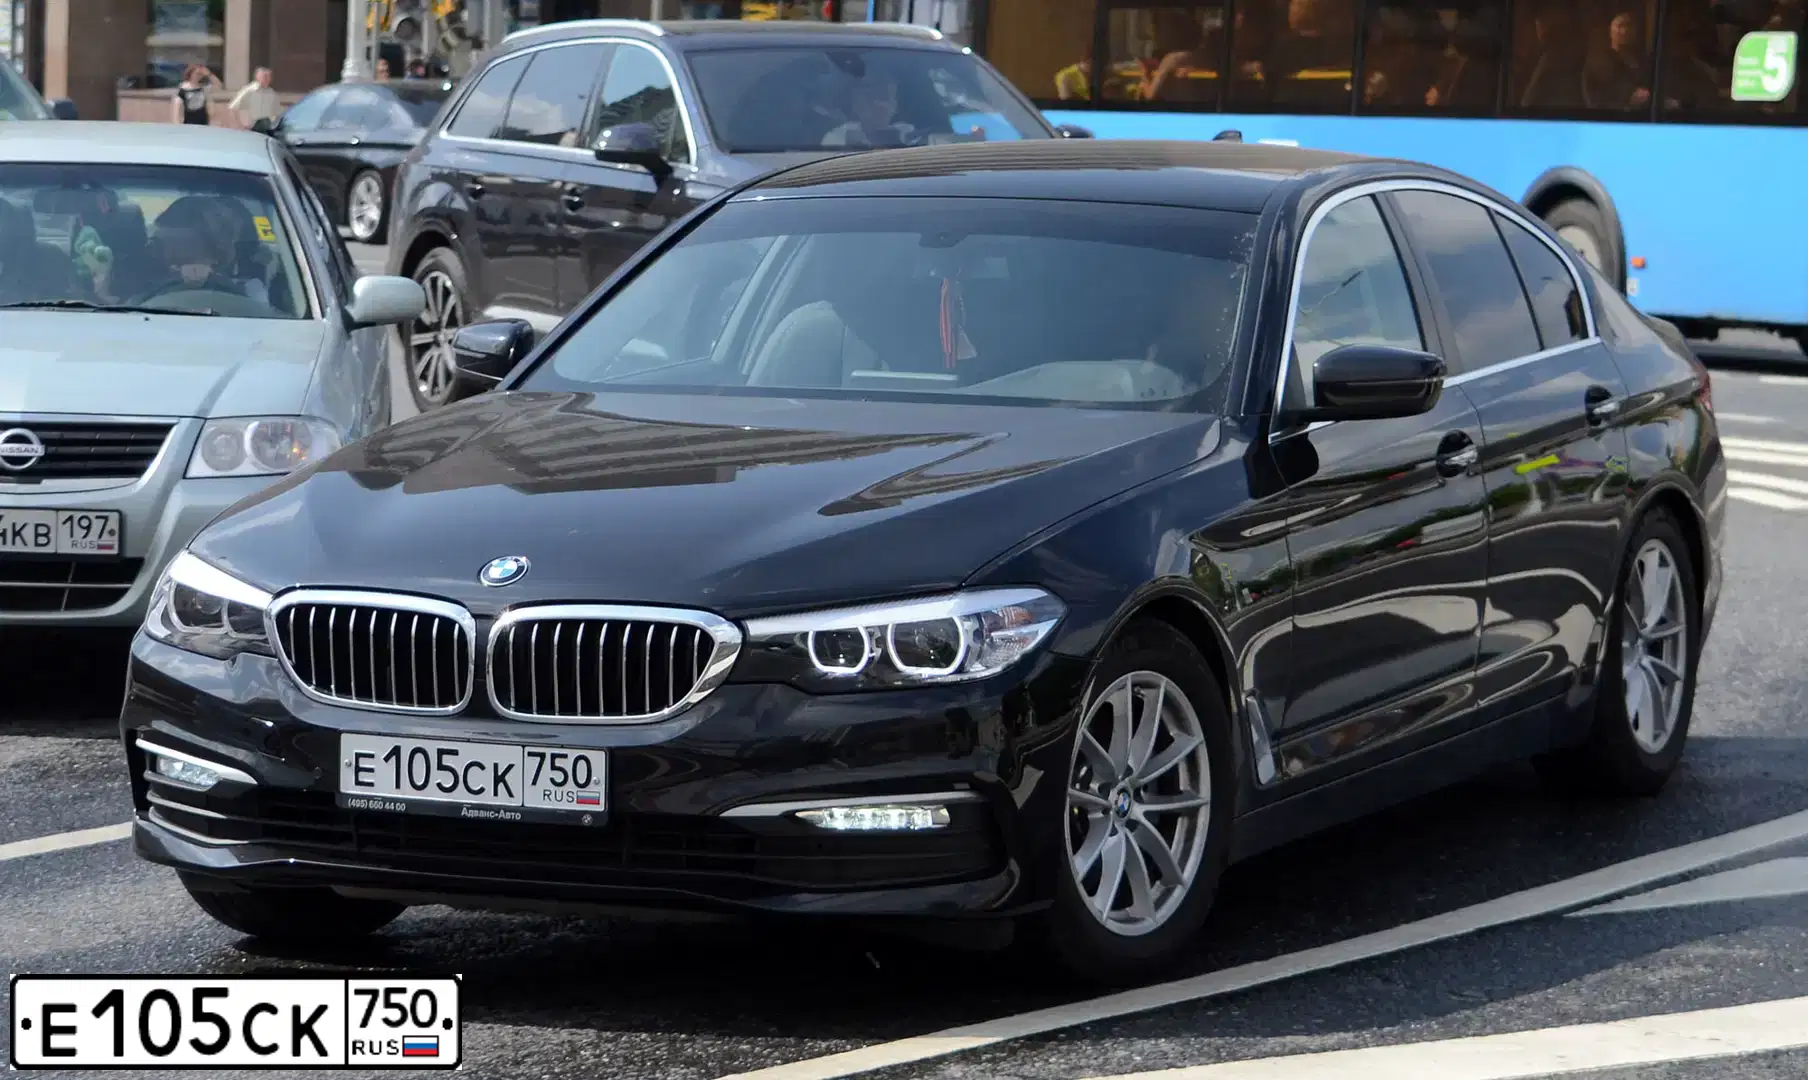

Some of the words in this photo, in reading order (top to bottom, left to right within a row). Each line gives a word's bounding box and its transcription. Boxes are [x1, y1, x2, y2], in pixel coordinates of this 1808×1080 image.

[1761, 36, 1787, 93] 5
[62, 514, 109, 540] 197
[71, 540, 96, 549] RUS
[527, 751, 592, 789] 750
[543, 789, 575, 803] RUS
[348, 798, 368, 809] (495)
[385, 801, 395, 810] 44
[395, 802, 406, 812] 00
[461, 807, 522, 820] Адванс-Авто
